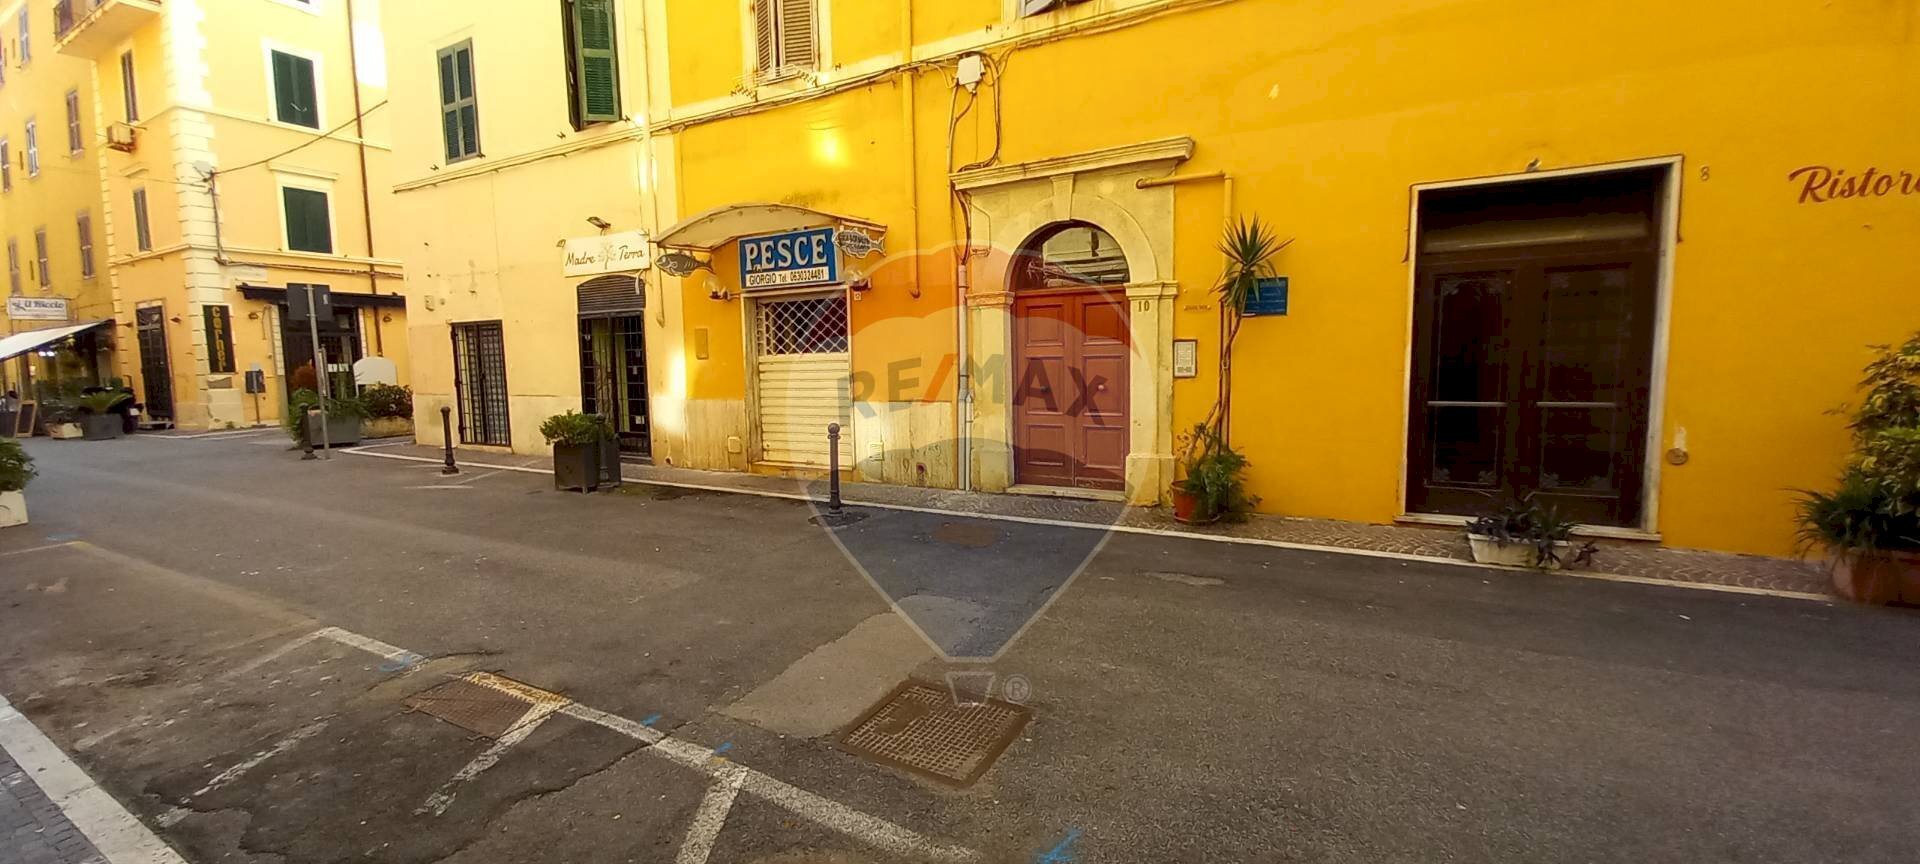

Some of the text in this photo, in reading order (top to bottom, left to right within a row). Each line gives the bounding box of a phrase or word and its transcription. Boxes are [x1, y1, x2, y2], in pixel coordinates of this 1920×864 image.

[564, 244, 644, 267] Madre Terra
[744, 233, 828, 272] PESCE
[749, 272, 777, 286] GIORGIO
[1138, 300, 1150, 313] 10
